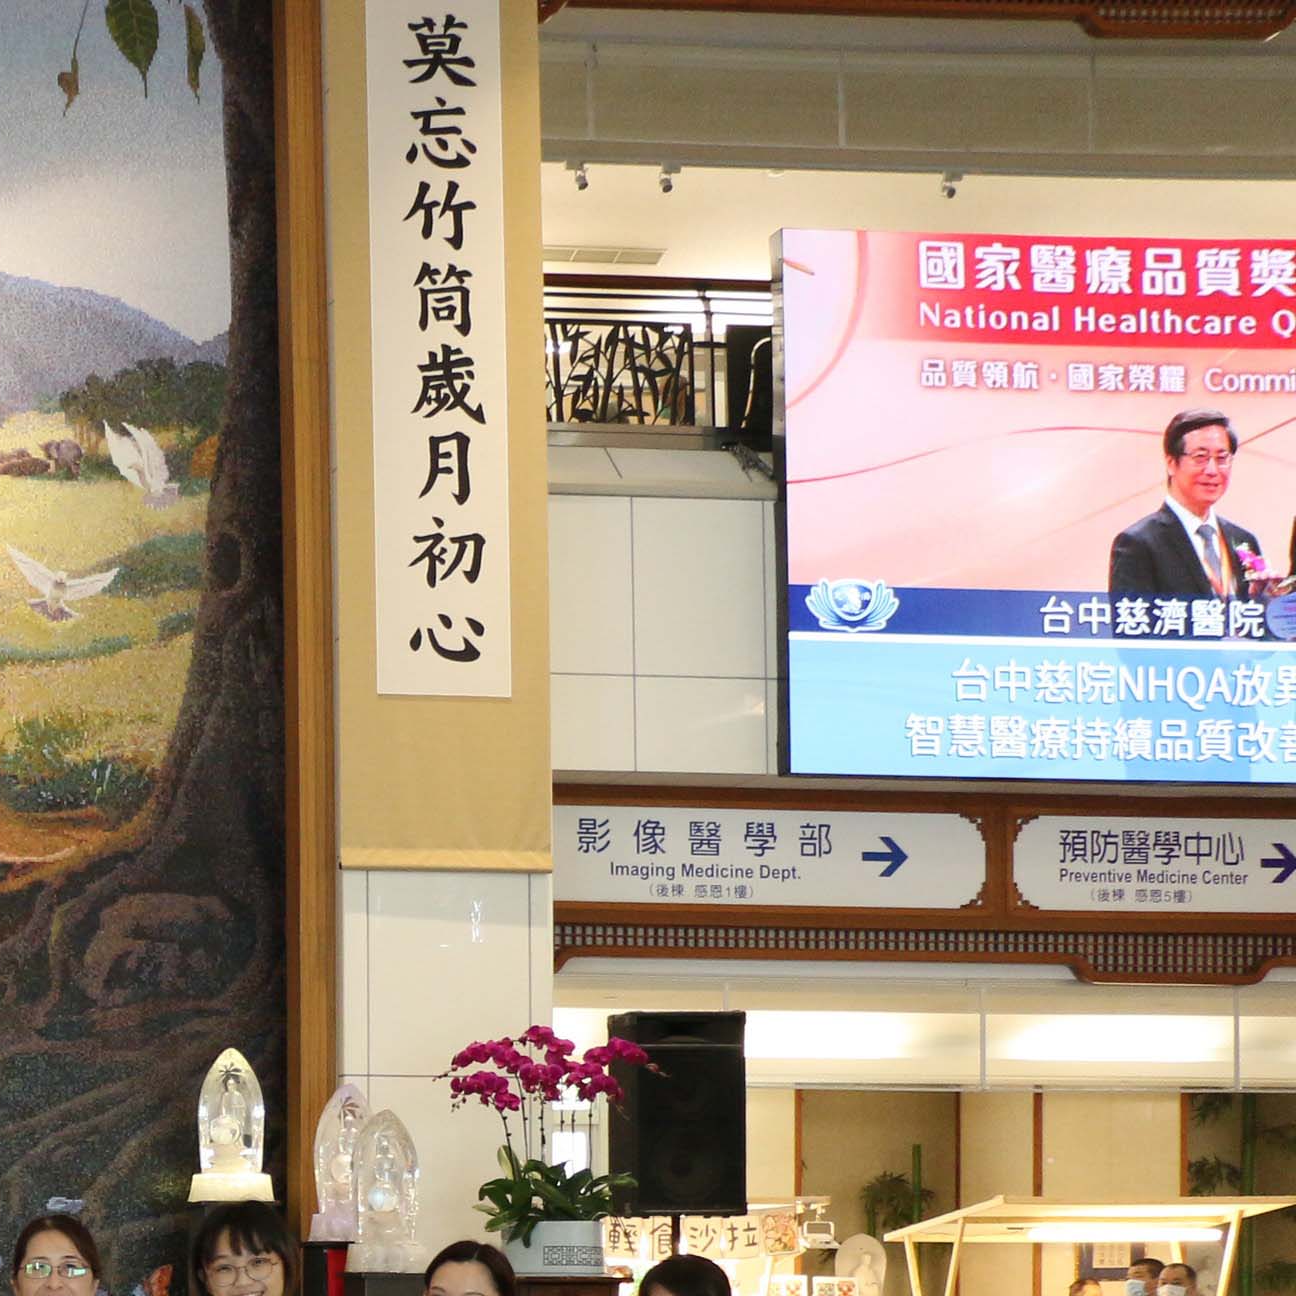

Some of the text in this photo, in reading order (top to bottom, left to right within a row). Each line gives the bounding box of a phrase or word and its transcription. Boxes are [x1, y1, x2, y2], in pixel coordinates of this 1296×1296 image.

[919, 240, 1296, 298] 國家醫療品質獎
[919, 302, 1061, 333] National
[1074, 305, 1258, 336] Healthcare
[402, 14, 487, 664] 莫忘竹筒歲月初心
[1039, 595, 1265, 638] 台中慈濟醫院
[576, 818, 833, 858] 影像醫學部
[1059, 830, 1245, 866] 預防醫學中心
[610, 861, 802, 882] Imaging Medicine Dept.
[1060, 868, 1248, 886] Preventive Medicine Center
